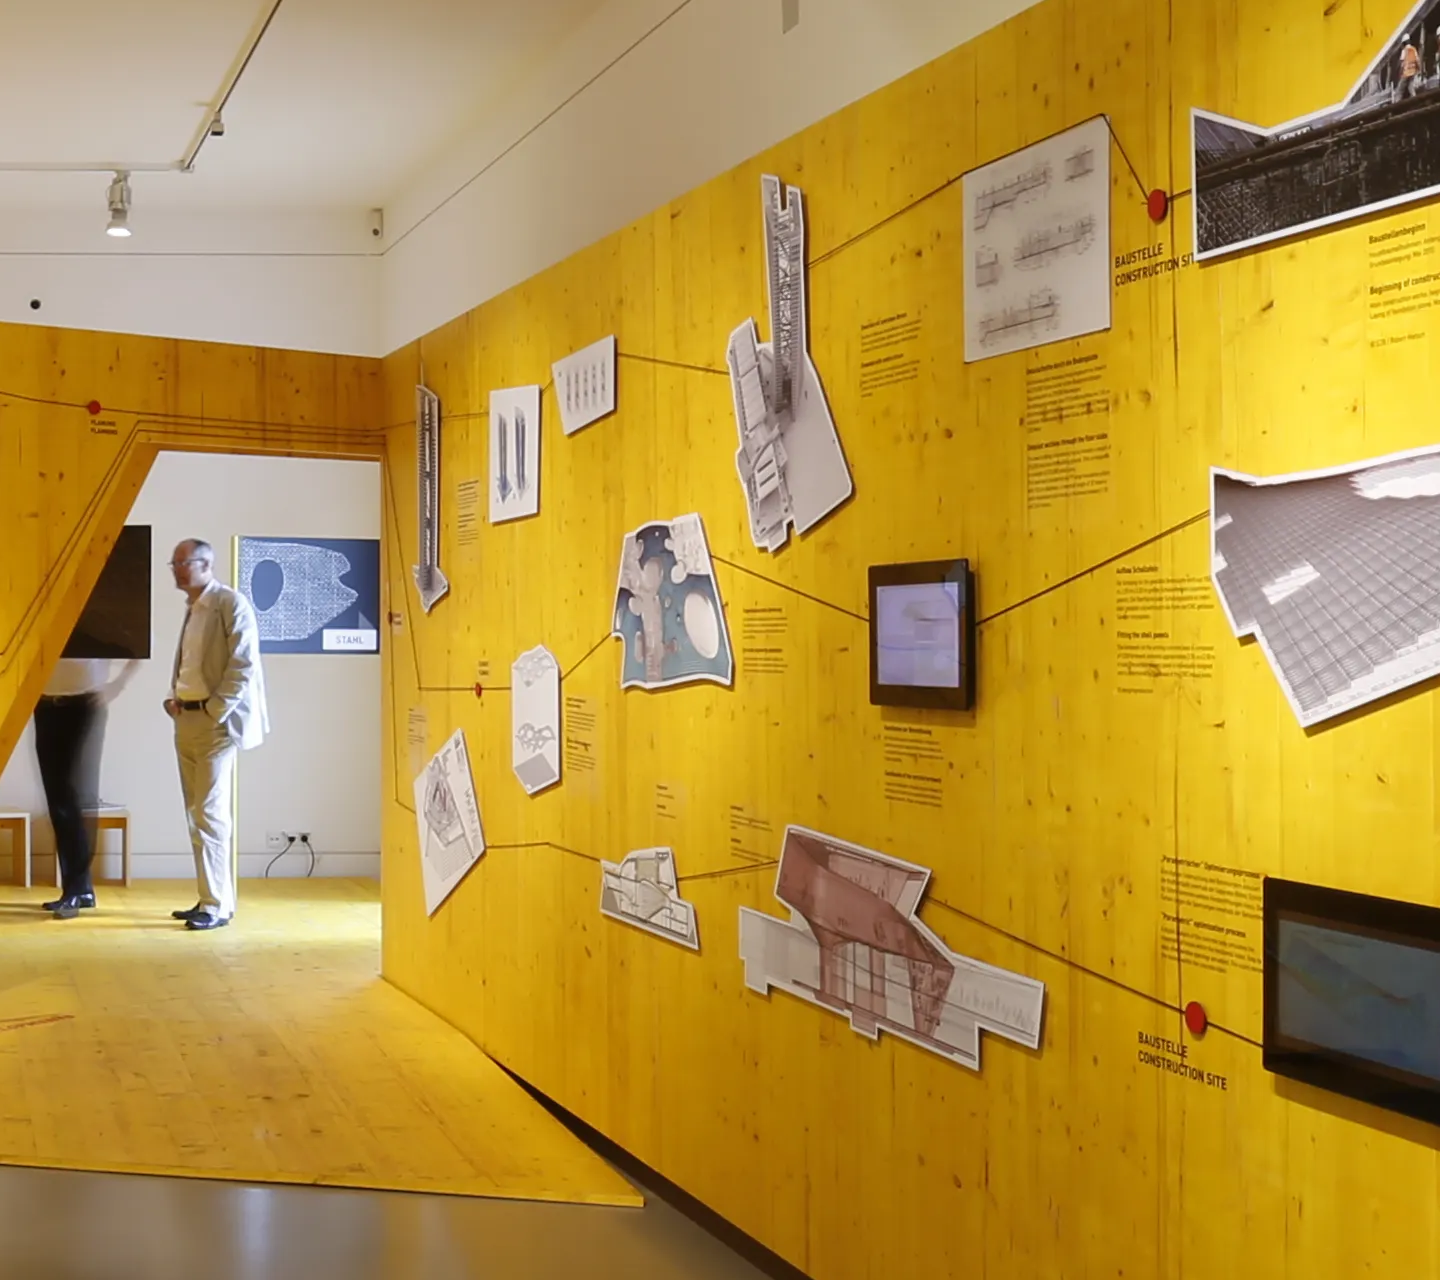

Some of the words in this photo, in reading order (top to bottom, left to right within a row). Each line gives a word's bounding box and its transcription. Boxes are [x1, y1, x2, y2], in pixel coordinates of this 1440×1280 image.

[1115, 242, 1163, 269] BAUSTELLE
[1115, 256, 1180, 287] CONSTRUCTION
[1180, 251, 1195, 268] SIT
[1403, 278, 1410, 288] of
[335, 635, 364, 645] STAHL
[1138, 1031, 1188, 1059] BAUSTELLE
[1138, 1050, 1205, 1084] CONSTRUCTION
[1206, 1072, 1227, 1091] SITE
